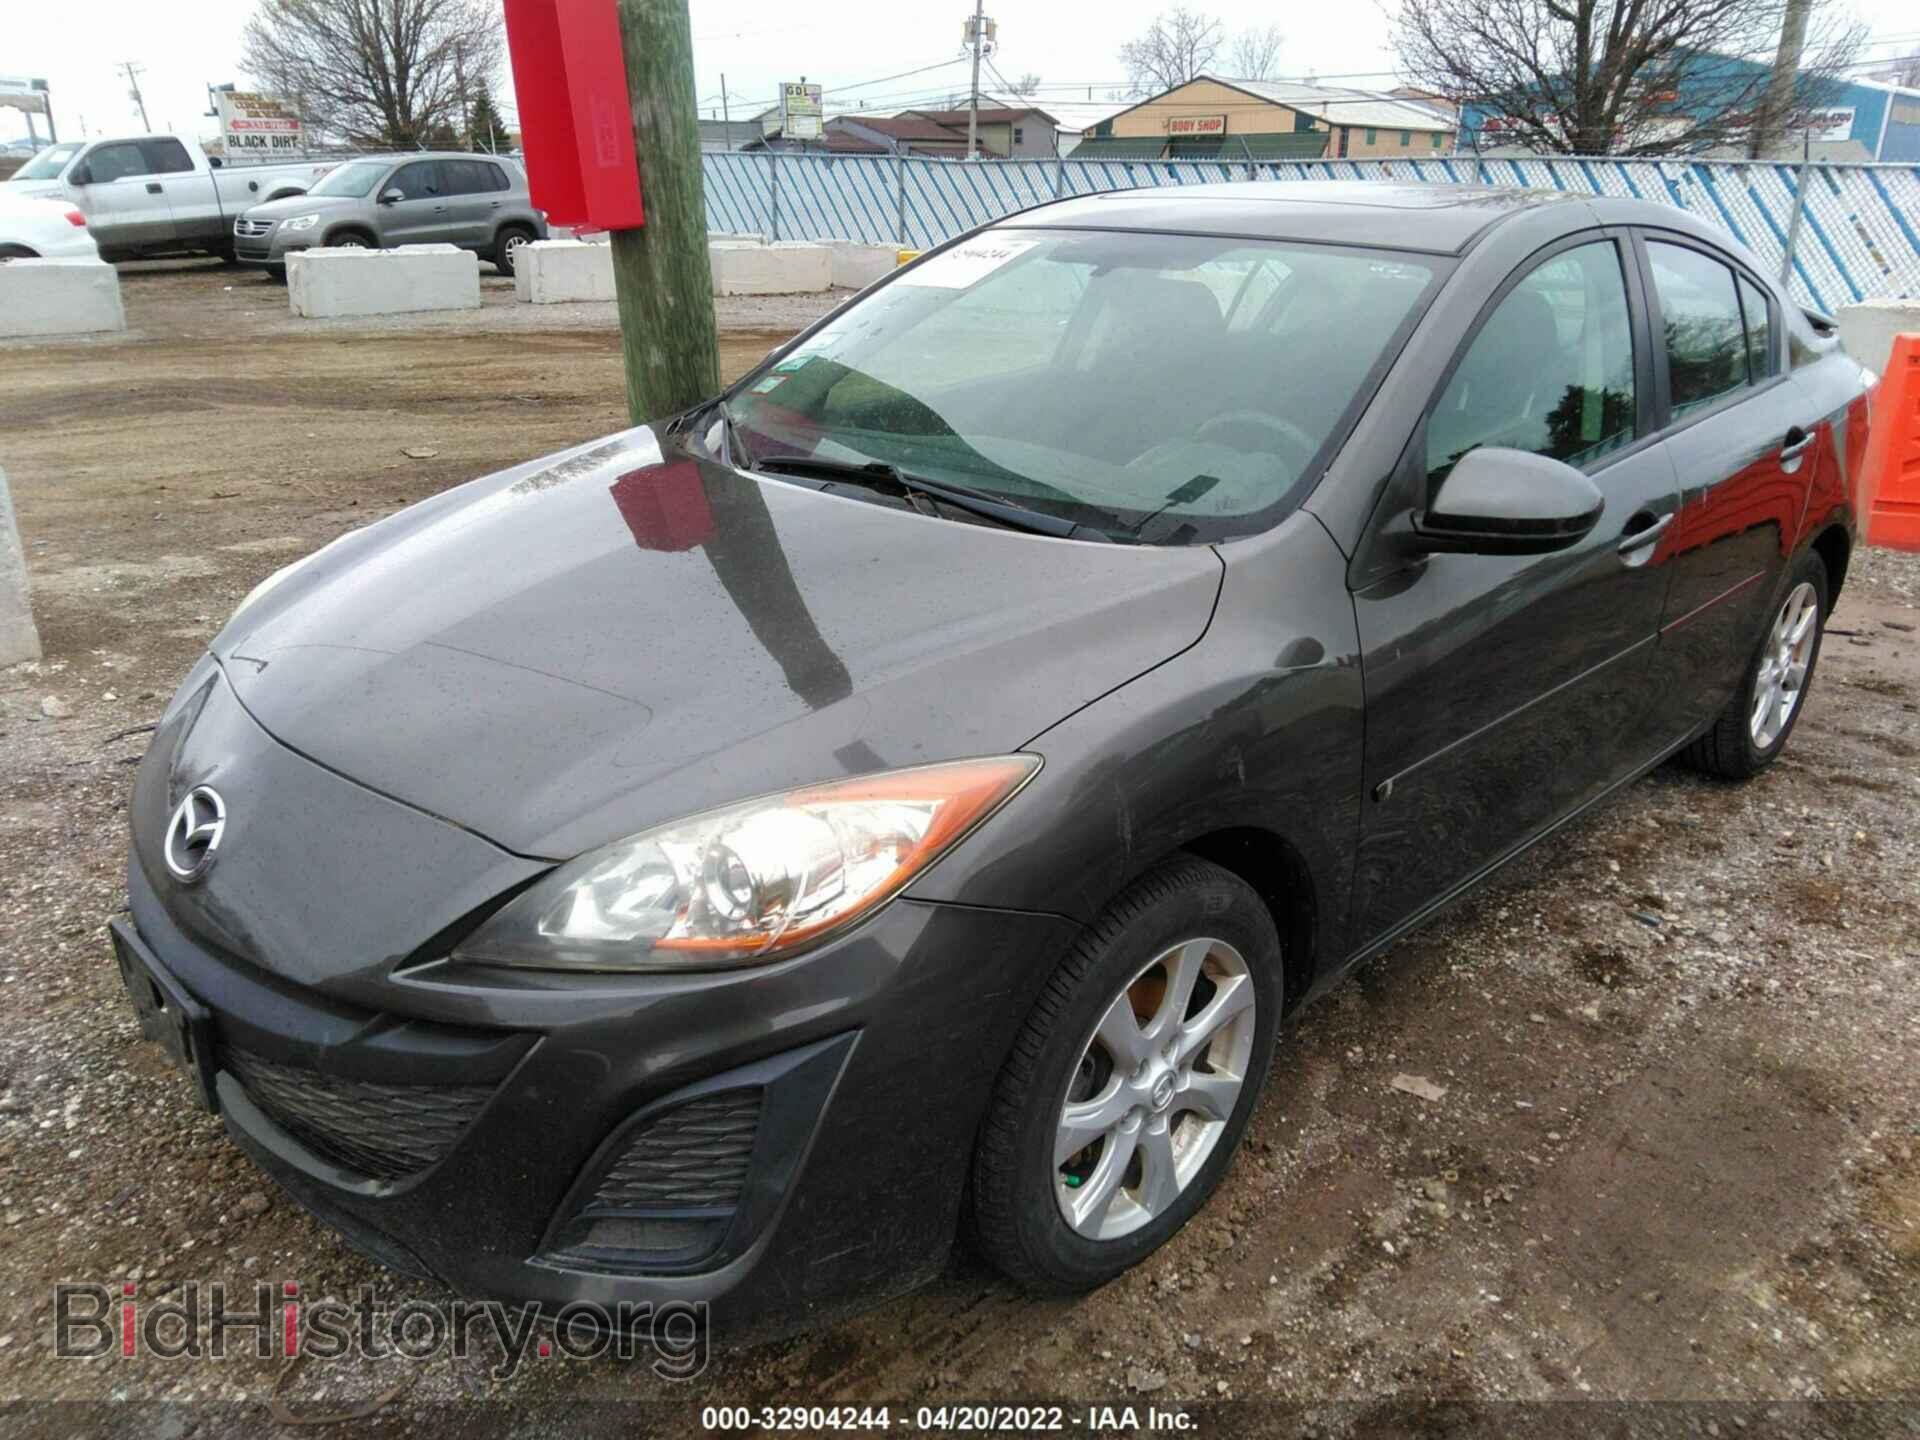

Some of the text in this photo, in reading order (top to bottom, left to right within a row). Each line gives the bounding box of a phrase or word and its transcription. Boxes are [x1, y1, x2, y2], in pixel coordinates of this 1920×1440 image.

[1171, 118, 1222, 132] BODY SHOP
[228, 134, 298, 148] BLACK DIRT
